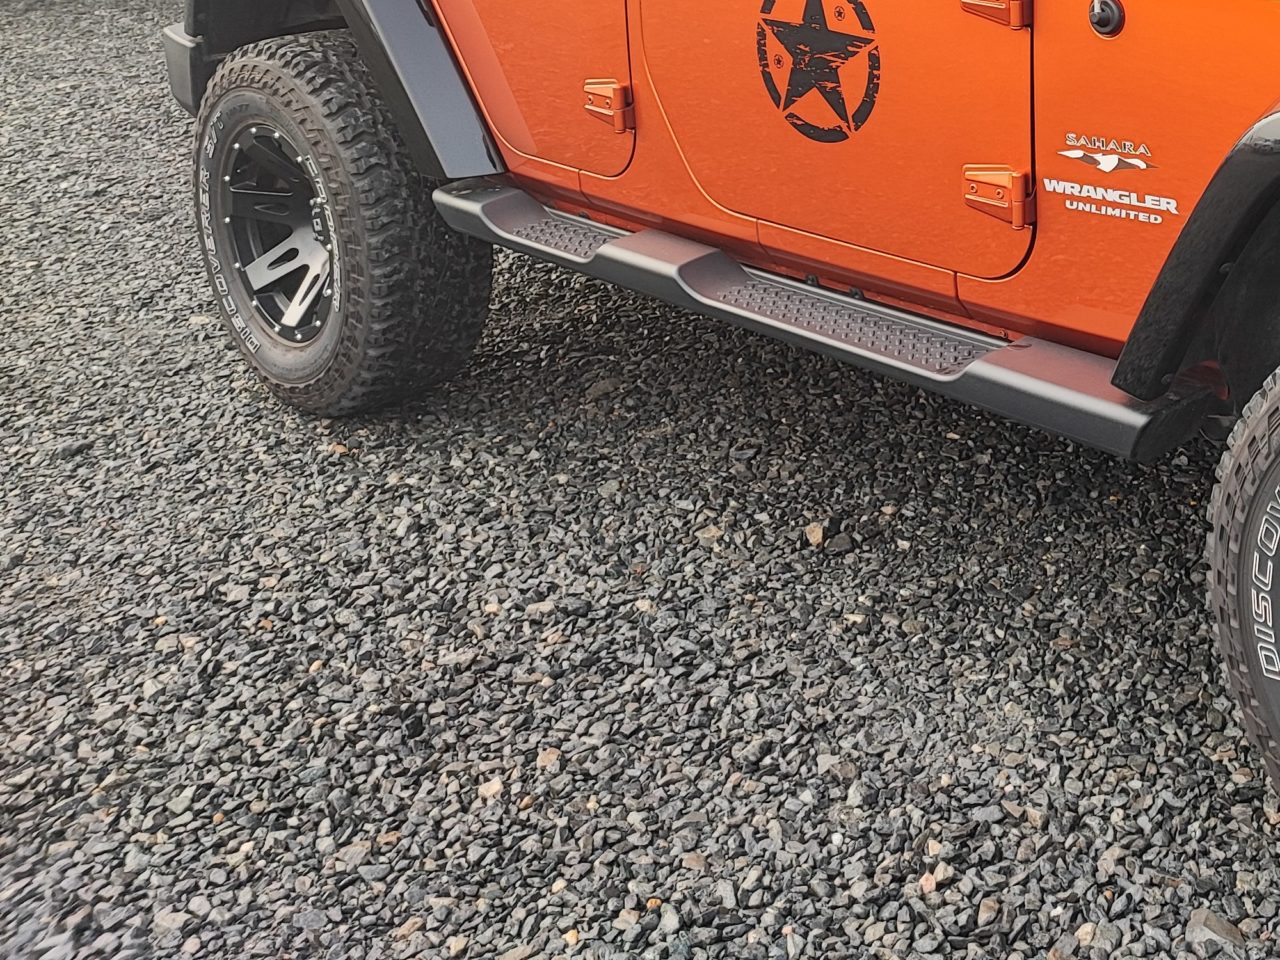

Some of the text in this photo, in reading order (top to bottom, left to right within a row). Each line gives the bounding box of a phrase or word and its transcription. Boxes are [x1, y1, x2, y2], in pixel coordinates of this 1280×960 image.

[1065, 132, 1152, 156] SAHARA
[1043, 178, 1179, 215] WRANGLER
[1065, 199, 1163, 224] UNLIMITED
